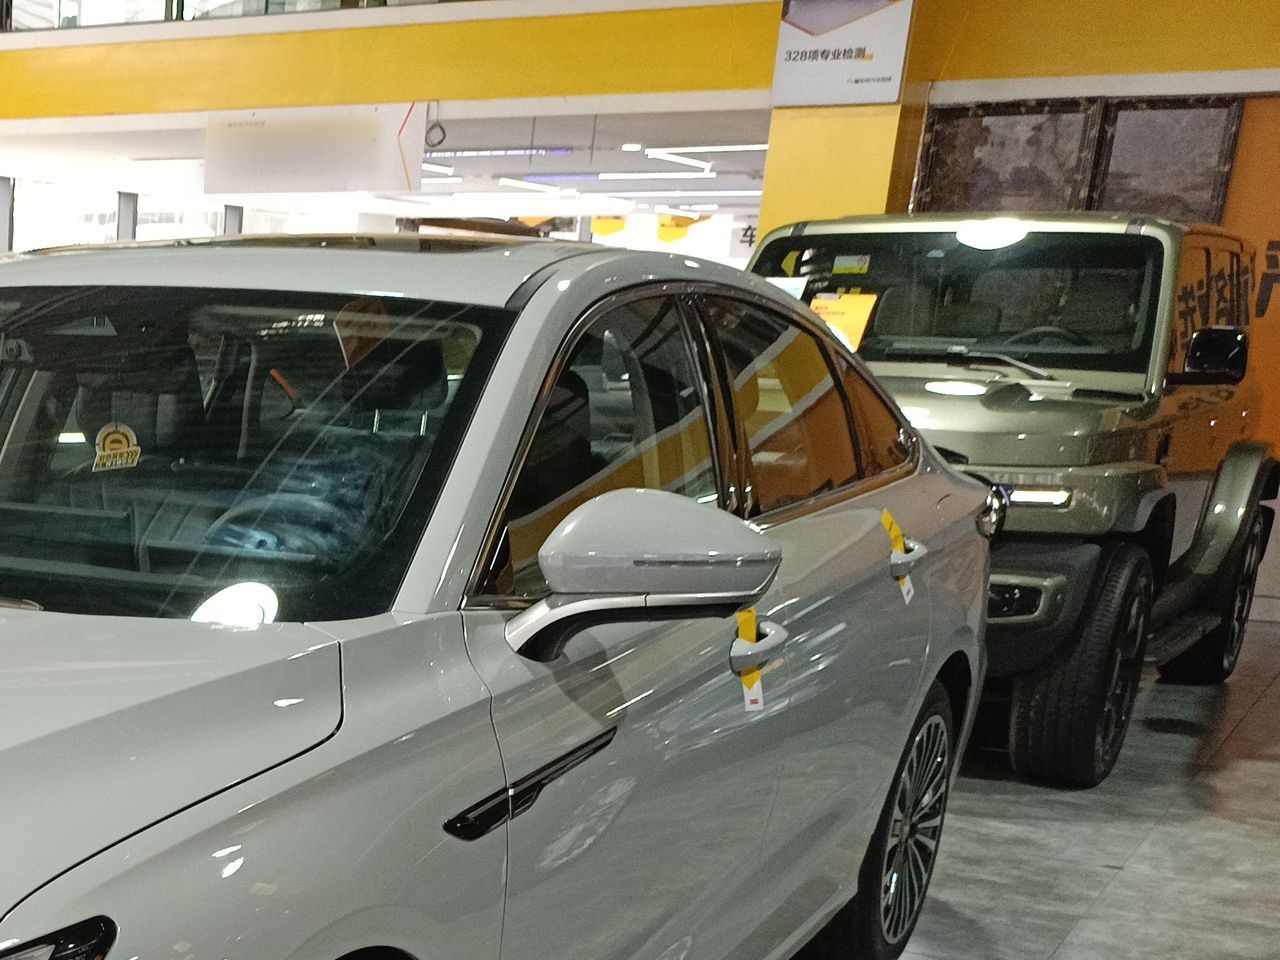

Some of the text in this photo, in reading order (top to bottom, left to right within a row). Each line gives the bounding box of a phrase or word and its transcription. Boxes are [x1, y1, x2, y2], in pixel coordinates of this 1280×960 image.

[784, 47, 867, 62] 328项专业检测
